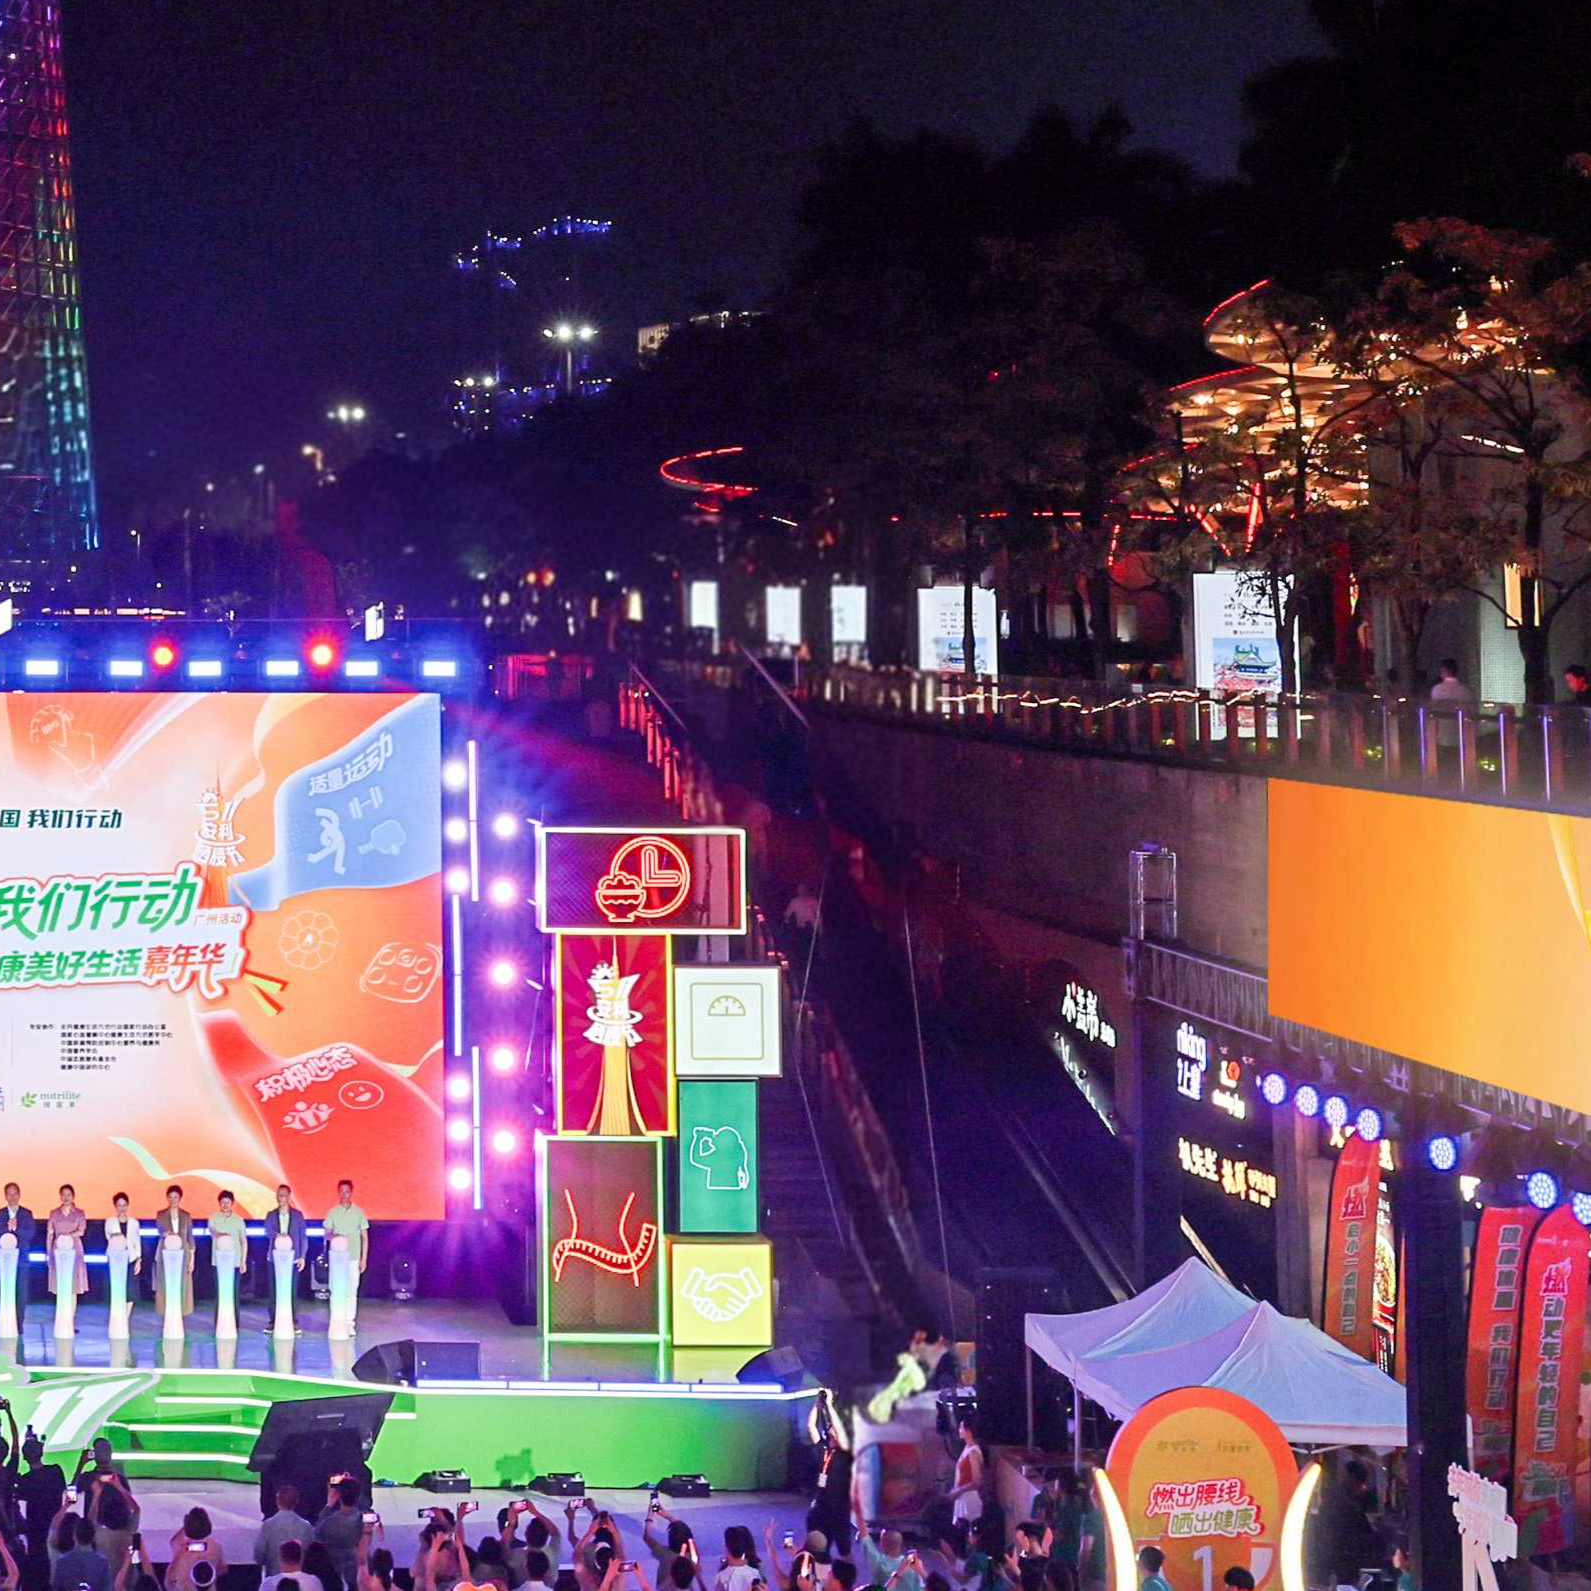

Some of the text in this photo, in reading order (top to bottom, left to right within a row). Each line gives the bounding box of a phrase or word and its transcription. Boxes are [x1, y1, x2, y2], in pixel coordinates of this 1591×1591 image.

[308, 731, 394, 797] 适量运动
[27, 807, 122, 829] 我们行动
[194, 912, 242, 927] 广州活动
[254, 1046, 358, 1102] 积极心态
[39, 1091, 81, 1101] nutrilite
[1150, 1481, 1248, 1511] 燃出腰线
[1170, 1507, 1257, 1535] 晒出健康
